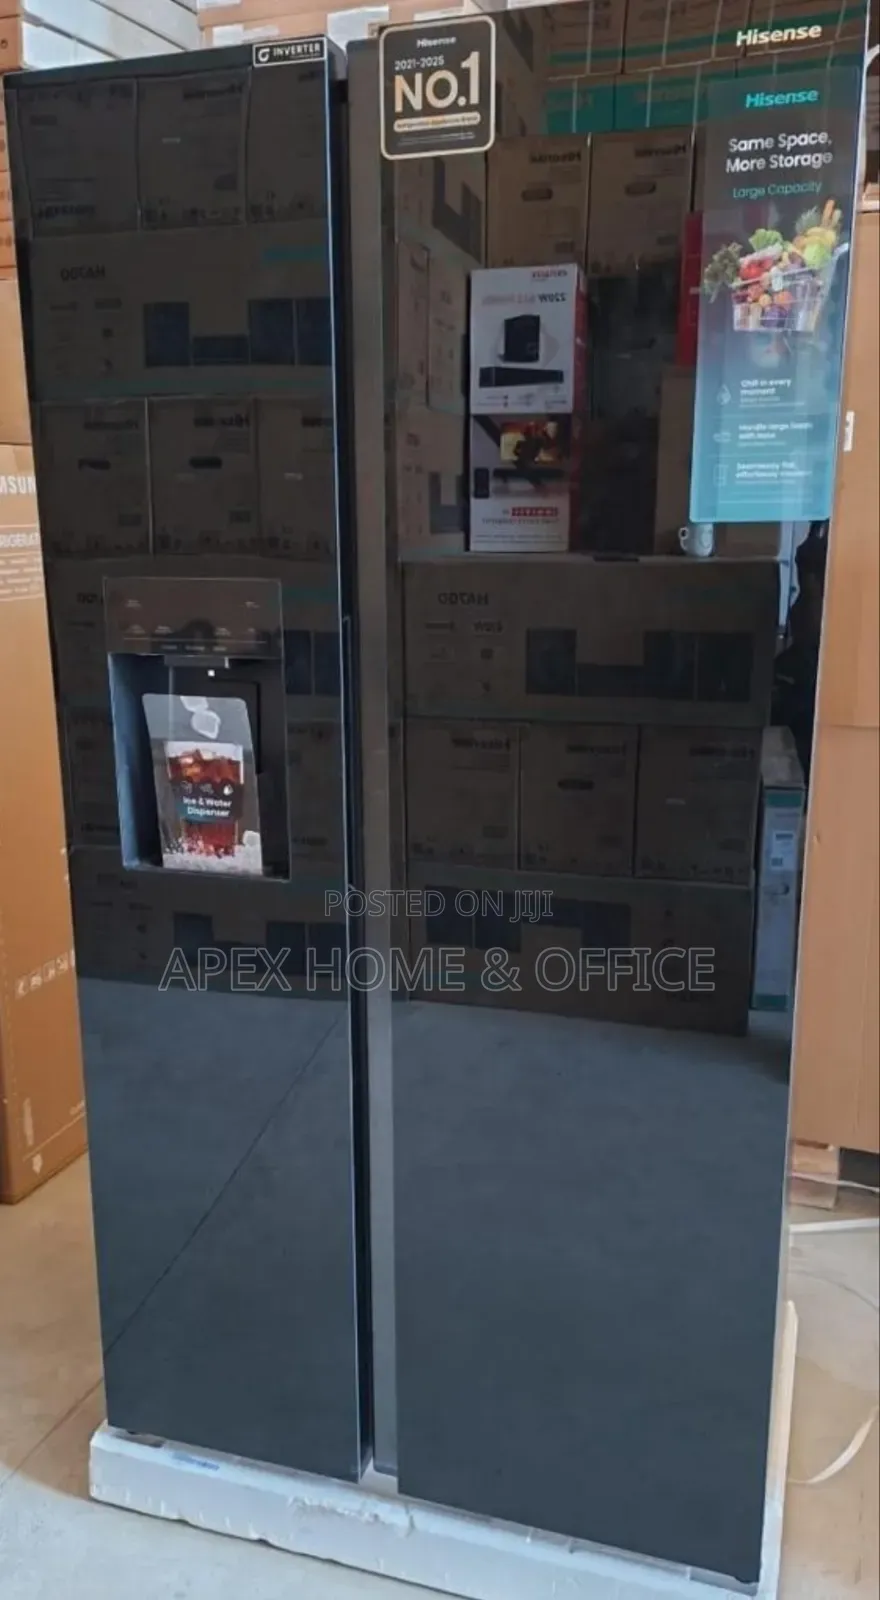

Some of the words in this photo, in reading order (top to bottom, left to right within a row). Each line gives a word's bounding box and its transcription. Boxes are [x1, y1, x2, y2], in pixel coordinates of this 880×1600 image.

[416, 35, 457, 48] Hisense
[736, 24, 822, 47] Hisense
[273, 42, 321, 57] INVERTER
[394, 55, 445, 71] 2021-2025
[394, 51, 480, 113] NO.1
[745, 89, 819, 109] Hisense
[728, 136, 775, 153] Same
[778, 131, 832, 151] Space,
[726, 157, 766, 173] More
[770, 152, 833, 169] Storage
[733, 186, 766, 200] Large
[768, 181, 823, 196] Capacity
[183, 796, 197, 805] Ice
[198, 797, 205, 806] &
[205, 798, 233, 808] Water
[187, 806, 231, 818] Dispenser
